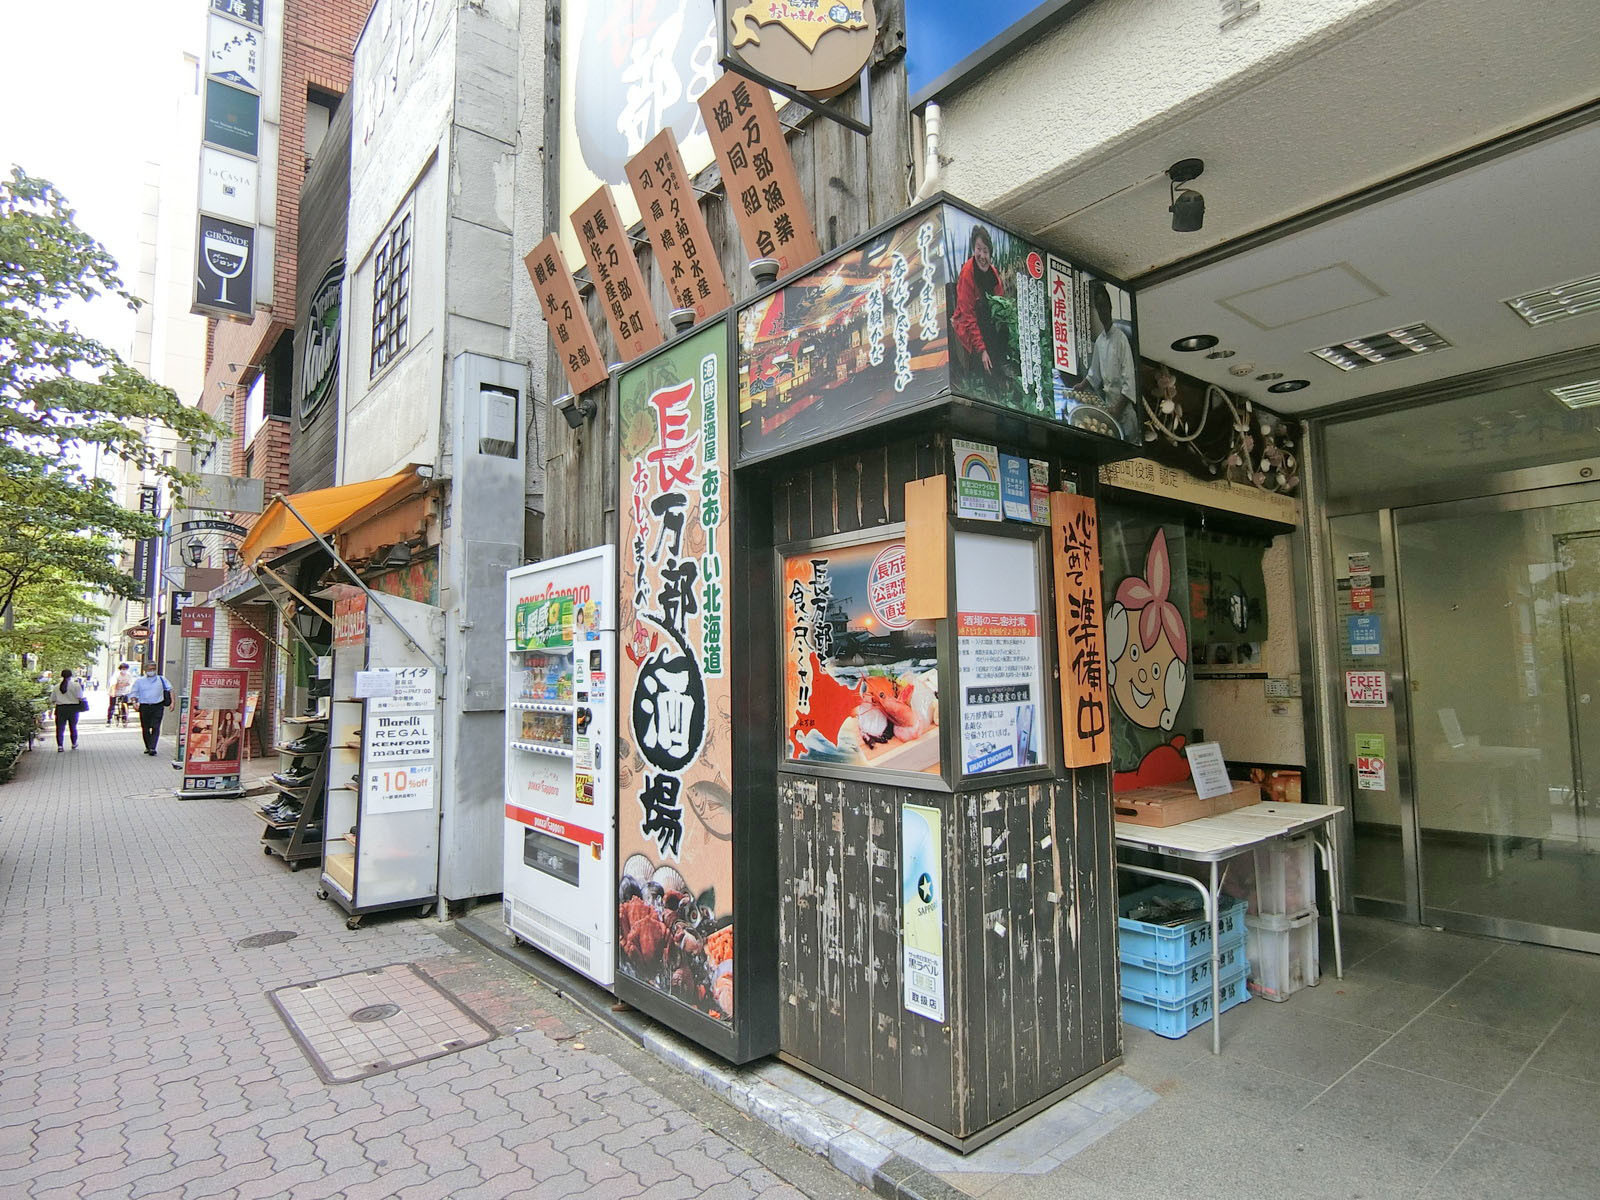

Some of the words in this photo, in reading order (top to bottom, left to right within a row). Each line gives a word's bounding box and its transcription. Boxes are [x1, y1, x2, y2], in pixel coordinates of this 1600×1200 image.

[226, 73, 242, 82] 3F
[732, 80, 795, 246] 長万部漁業
[713, 99, 776, 257] 協同組合
[205, 230, 249, 247] GIRONDE
[593, 208, 643, 333] 長万部町
[544, 254, 590, 366] 長万部
[1053, 274, 1069, 368] 大虎飯店
[703, 360, 717, 462] 海鮮居酒屋
[632, 461, 651, 607] おしゃまんべ
[702, 469, 722, 674] おおーい北海道
[637, 382, 700, 854] 長万部酒場
[963, 615, 1028, 627] 酒場の三密対策
[1350, 676, 1382, 687] FREE
[1350, 687, 1383, 700] Wi-Fi
[378, 716, 420, 727] Marelli
[375, 728, 429, 738] REGAL
[373, 748, 430, 757] madras
[969, 760, 988, 773] ENJOY
[384, 771, 407, 792] 10
[908, 958, 939, 977] 黒ラベル
[911, 991, 937, 1010] 取扱店
